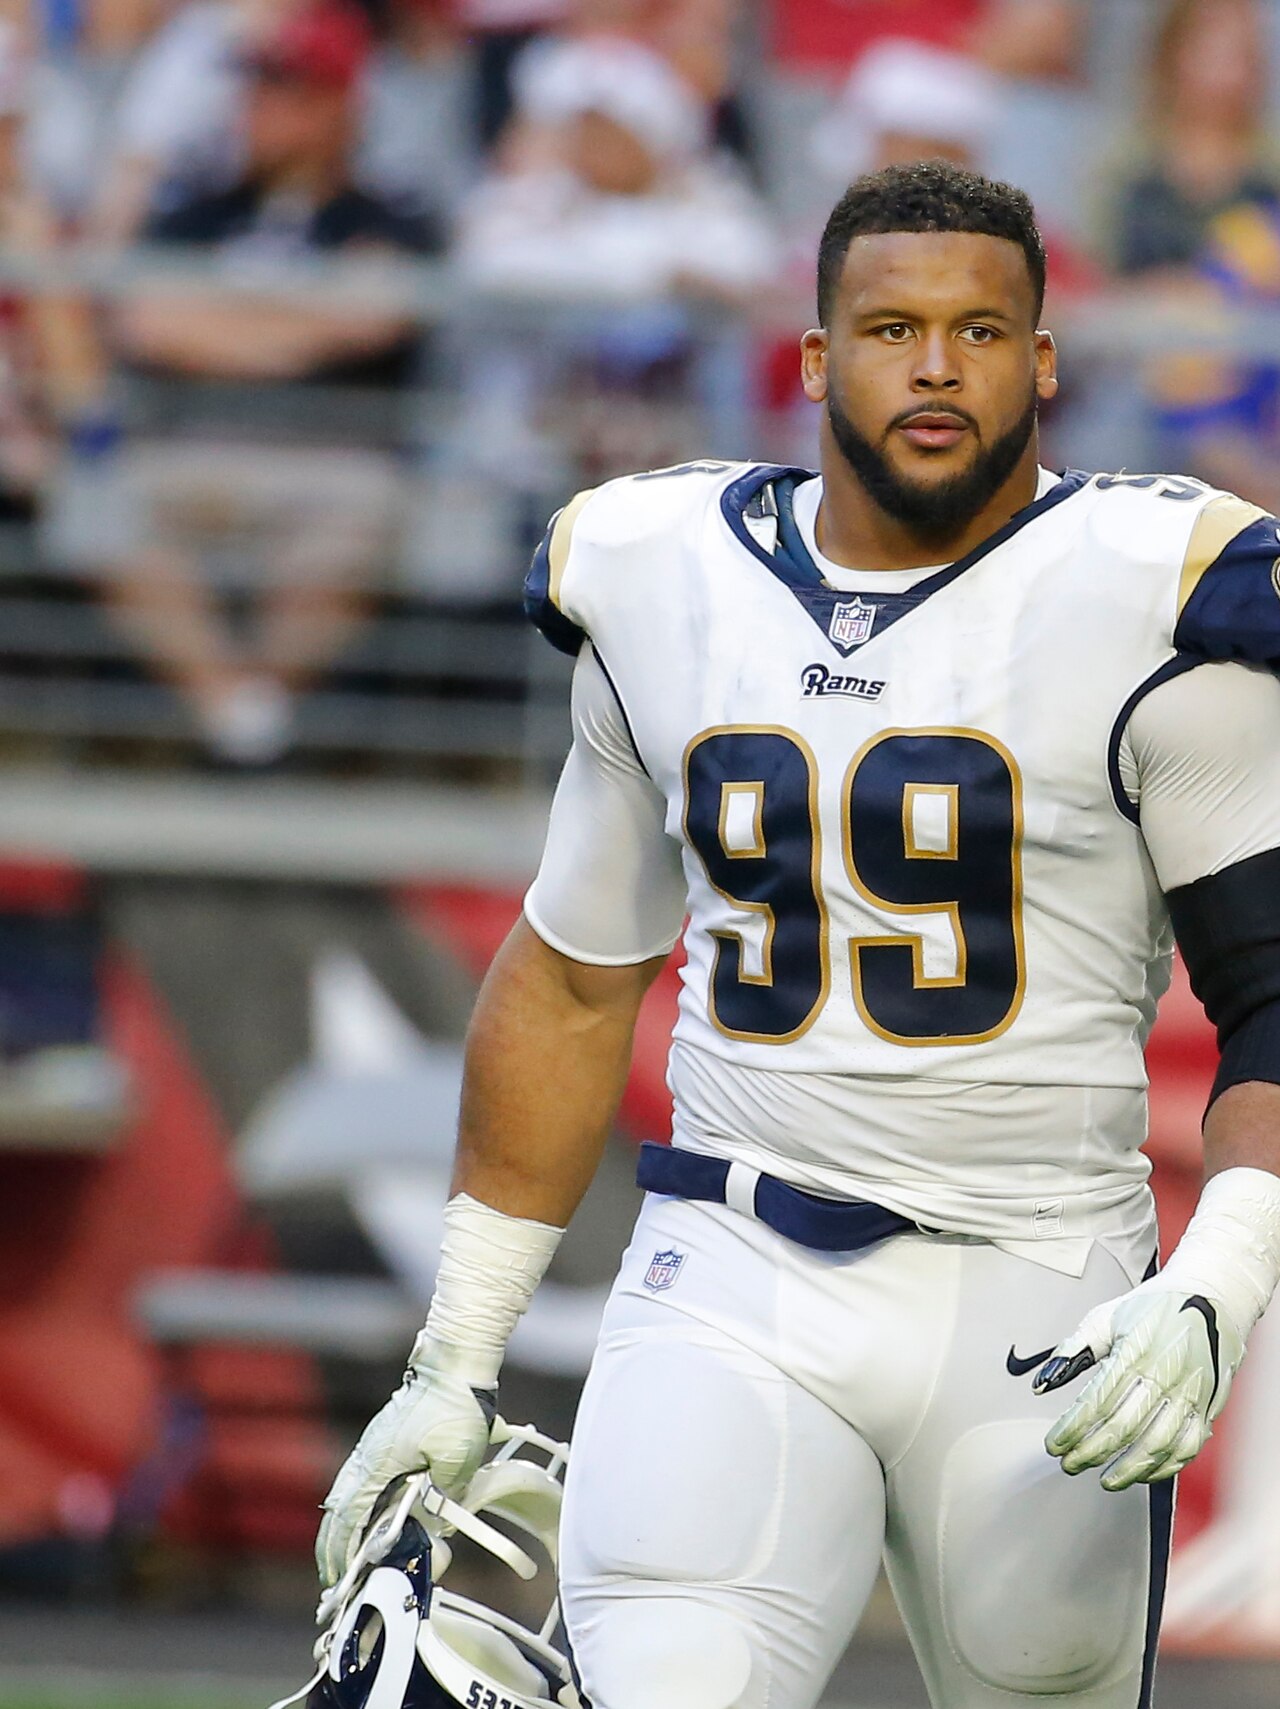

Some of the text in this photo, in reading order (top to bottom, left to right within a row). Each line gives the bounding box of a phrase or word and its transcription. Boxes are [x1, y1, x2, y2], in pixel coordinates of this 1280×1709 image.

[836, 620, 865, 640] NFL
[801, 663, 887, 700] Rams
[682, 723, 1026, 1047] 99
[647, 1265, 673, 1285] NFL
